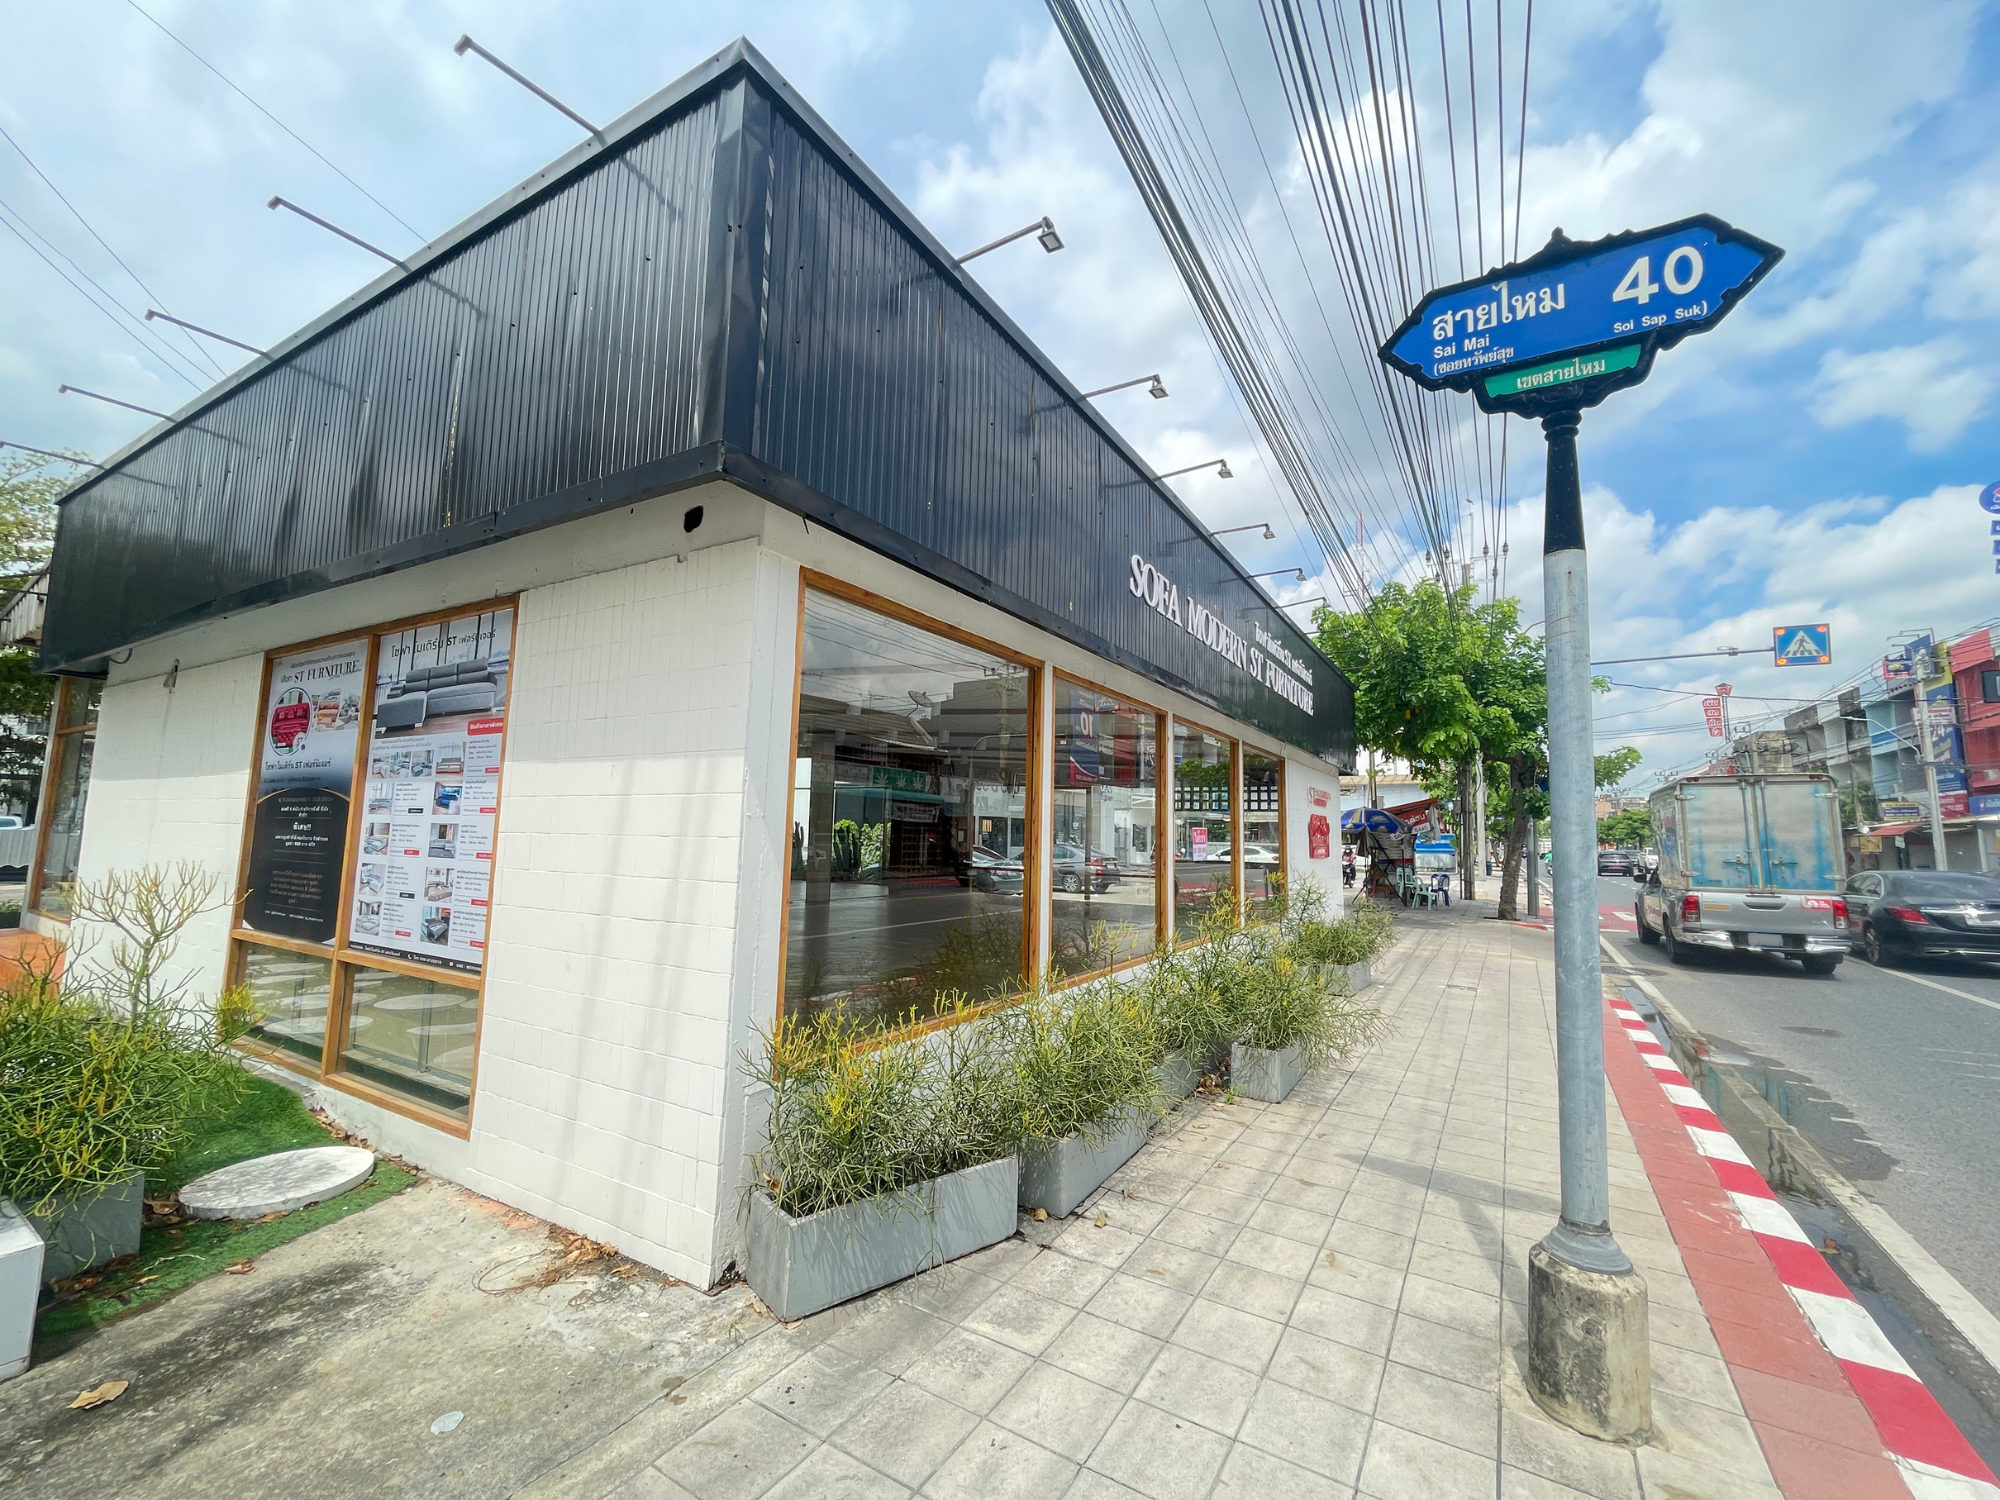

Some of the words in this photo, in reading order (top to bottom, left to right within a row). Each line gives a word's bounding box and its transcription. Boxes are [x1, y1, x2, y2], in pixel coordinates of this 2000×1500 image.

[1432, 281, 1565, 341] สายไหม
[1612, 246, 1704, 305] 40
[1613, 319, 1634, 333] Soi
[1641, 314, 1667, 326] Sap
[1674, 300, 1708, 319] Suk)
[1433, 343, 1456, 359] Sai
[1464, 334, 1490, 351] Mai
[1433, 345, 1514, 377] (ซอยทรัพย์สุข
[1516, 357, 1606, 390] เขตสายไหม
[447, 635, 457, 646] ST
[1129, 554, 1183, 627] SOFA
[1186, 597, 1247, 671] MODERN
[1249, 647, 1264, 683] ST
[1265, 658, 1314, 717] FURNITURE
[294, 671, 305, 683] ST
[307, 659, 360, 681] FURNITURE
[1284, 648, 1293, 670] ST
[295, 761, 302, 769] ST
